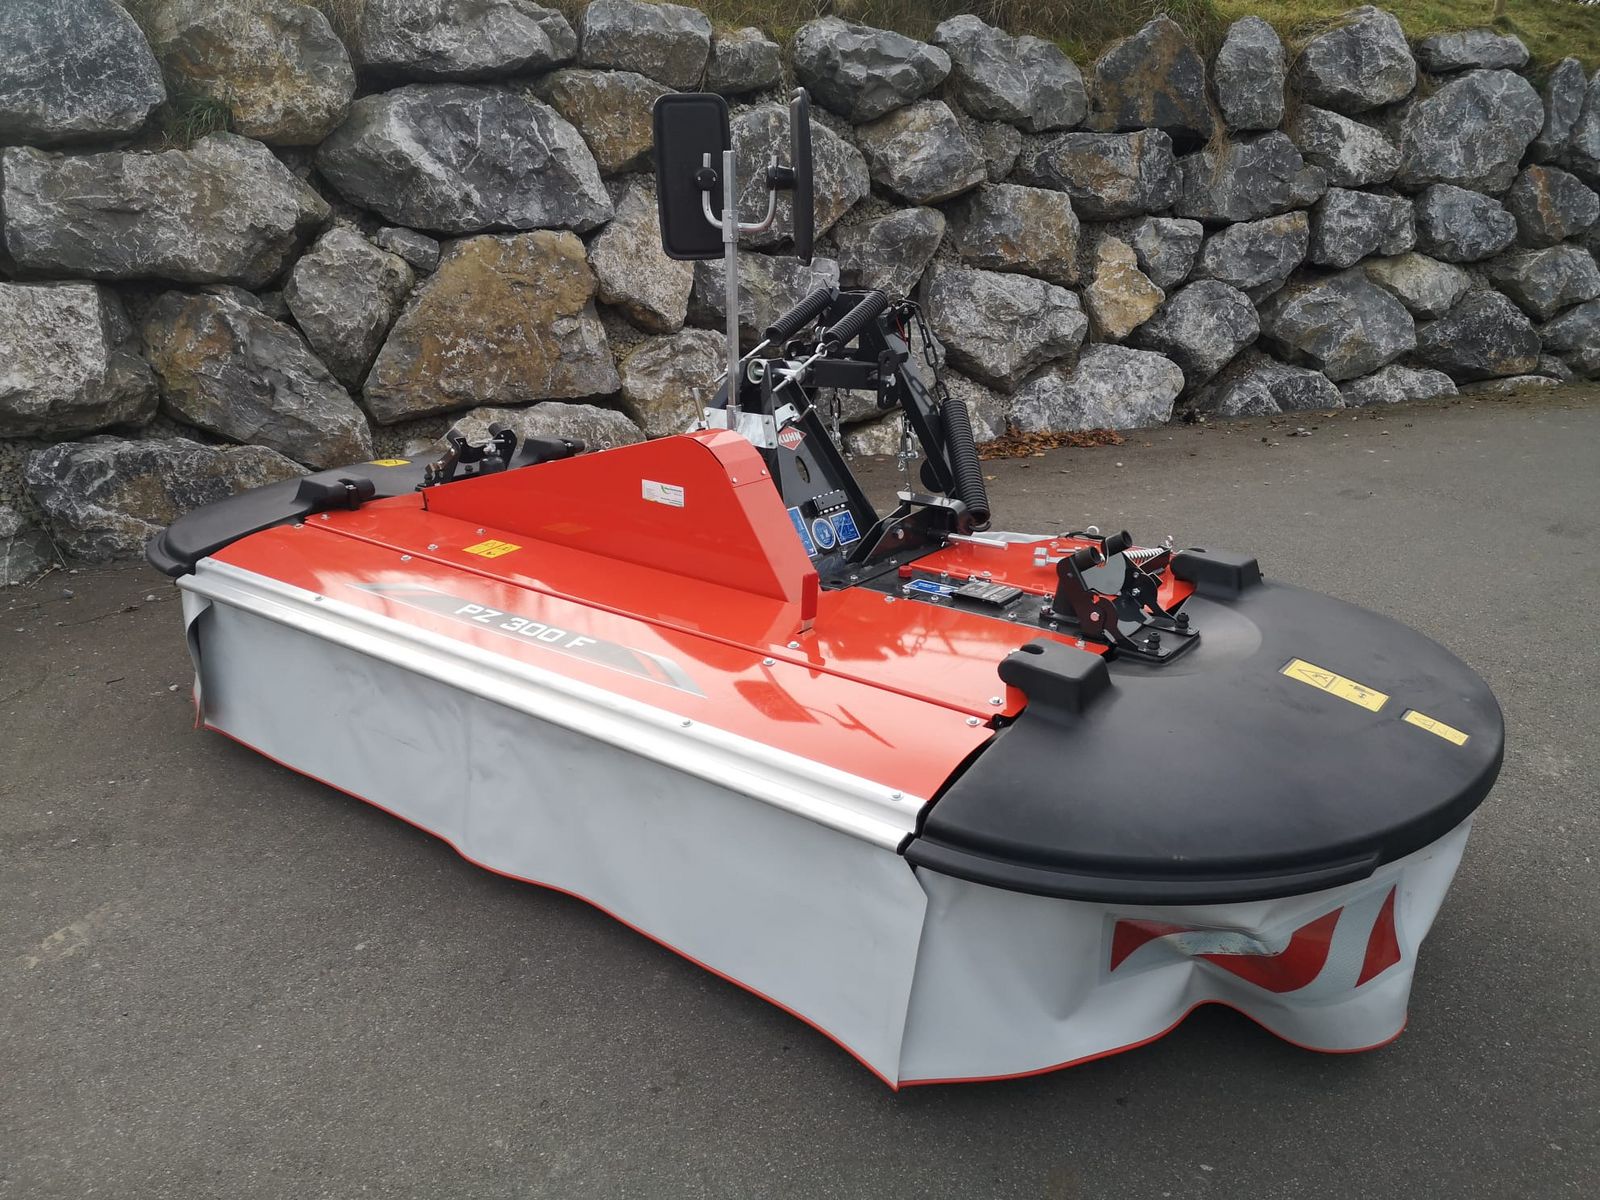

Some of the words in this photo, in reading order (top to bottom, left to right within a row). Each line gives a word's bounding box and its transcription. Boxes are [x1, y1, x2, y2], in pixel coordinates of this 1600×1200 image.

[455, 603, 504, 623] PZ
[499, 617, 567, 642] 300
[564, 637, 597, 648] F
